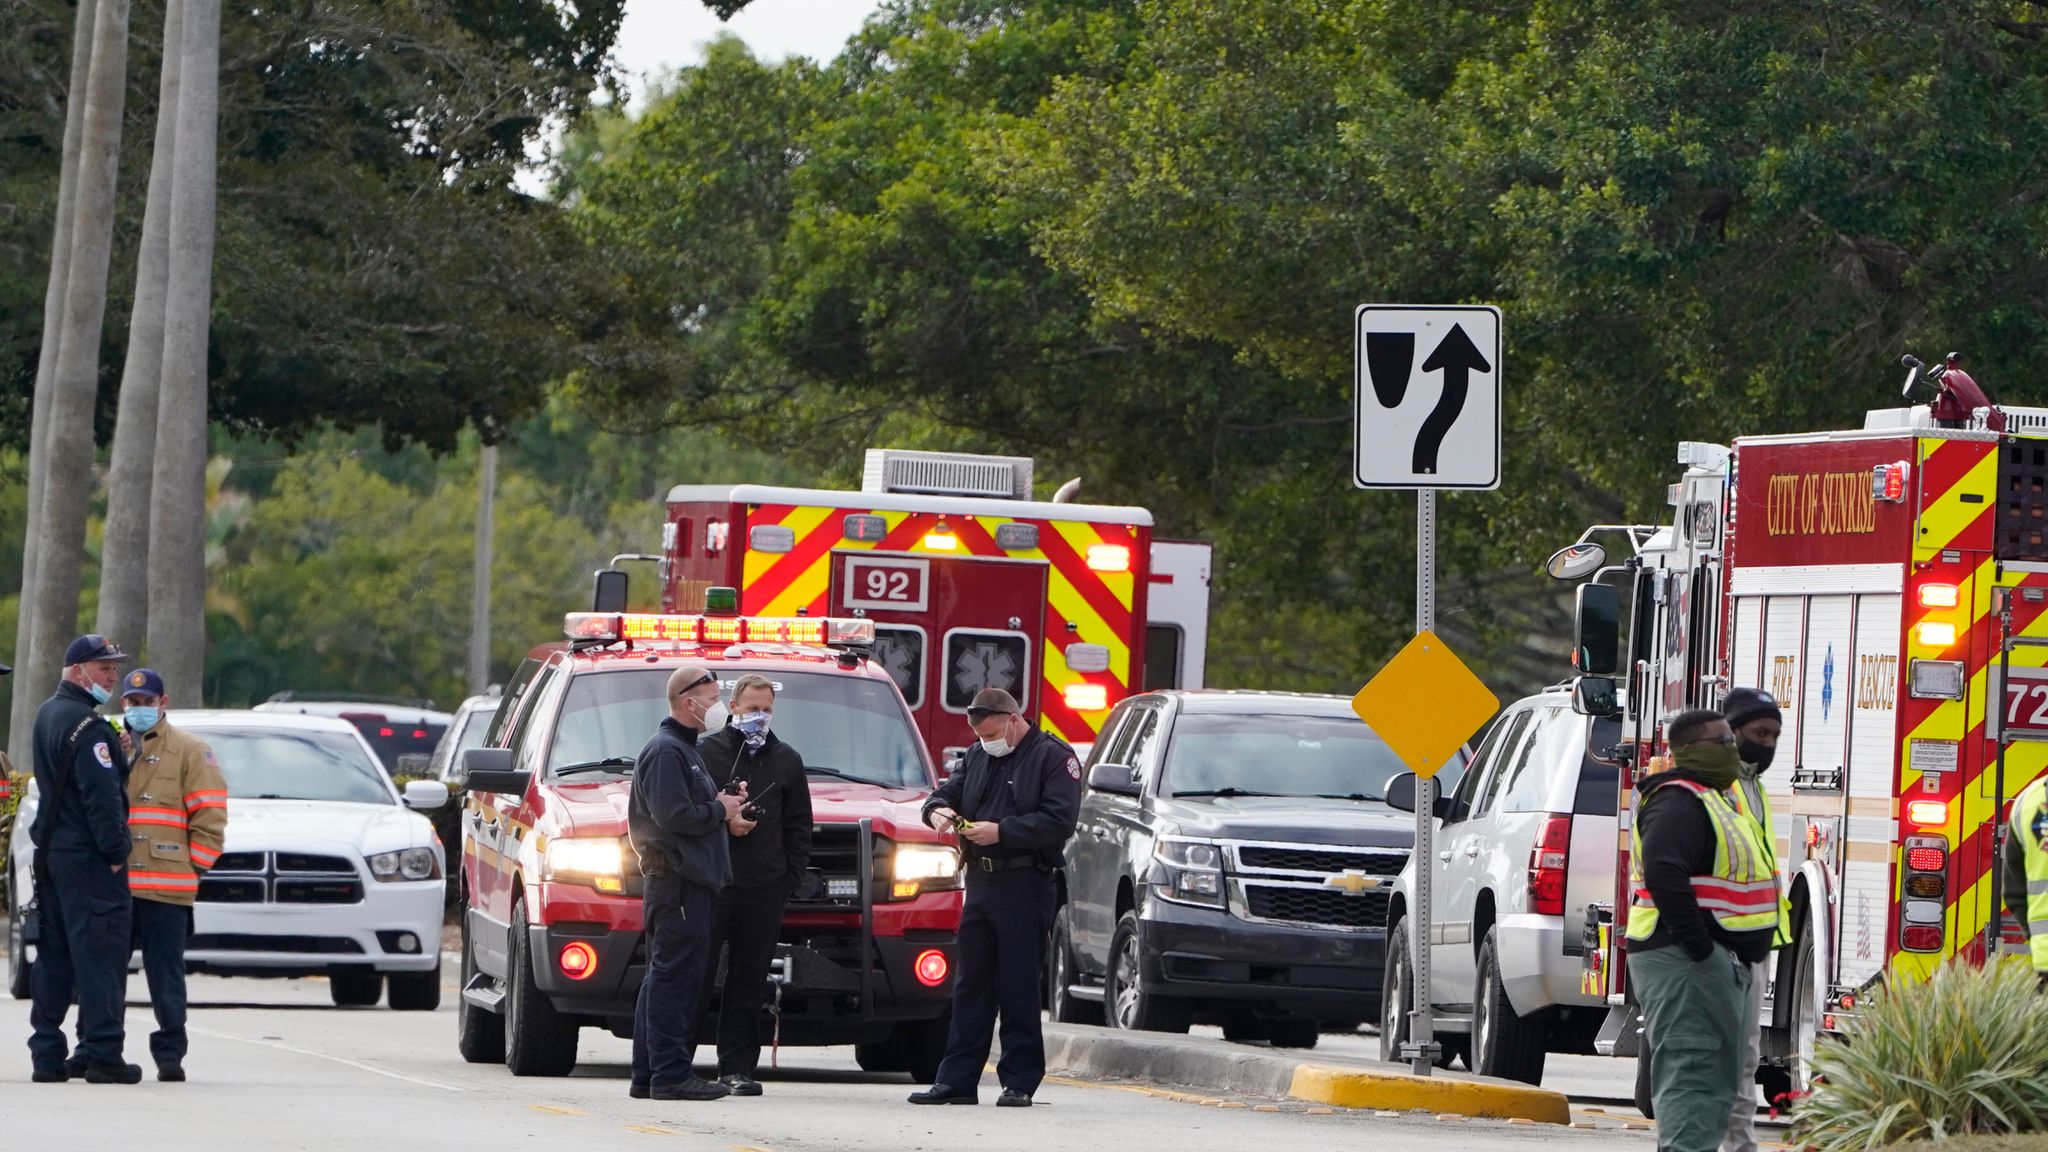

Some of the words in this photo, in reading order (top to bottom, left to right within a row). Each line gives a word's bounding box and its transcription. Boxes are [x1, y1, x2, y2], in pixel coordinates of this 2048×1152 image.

[1767, 474, 1799, 536] CITY
[1801, 473, 1820, 535] OF
[1820, 470, 1876, 535] SUNRISE
[867, 569, 909, 600] 92
[1772, 655, 1795, 708] FIRE
[1857, 653, 1897, 710] RESCUE
[2006, 684, 2048, 725] 72
